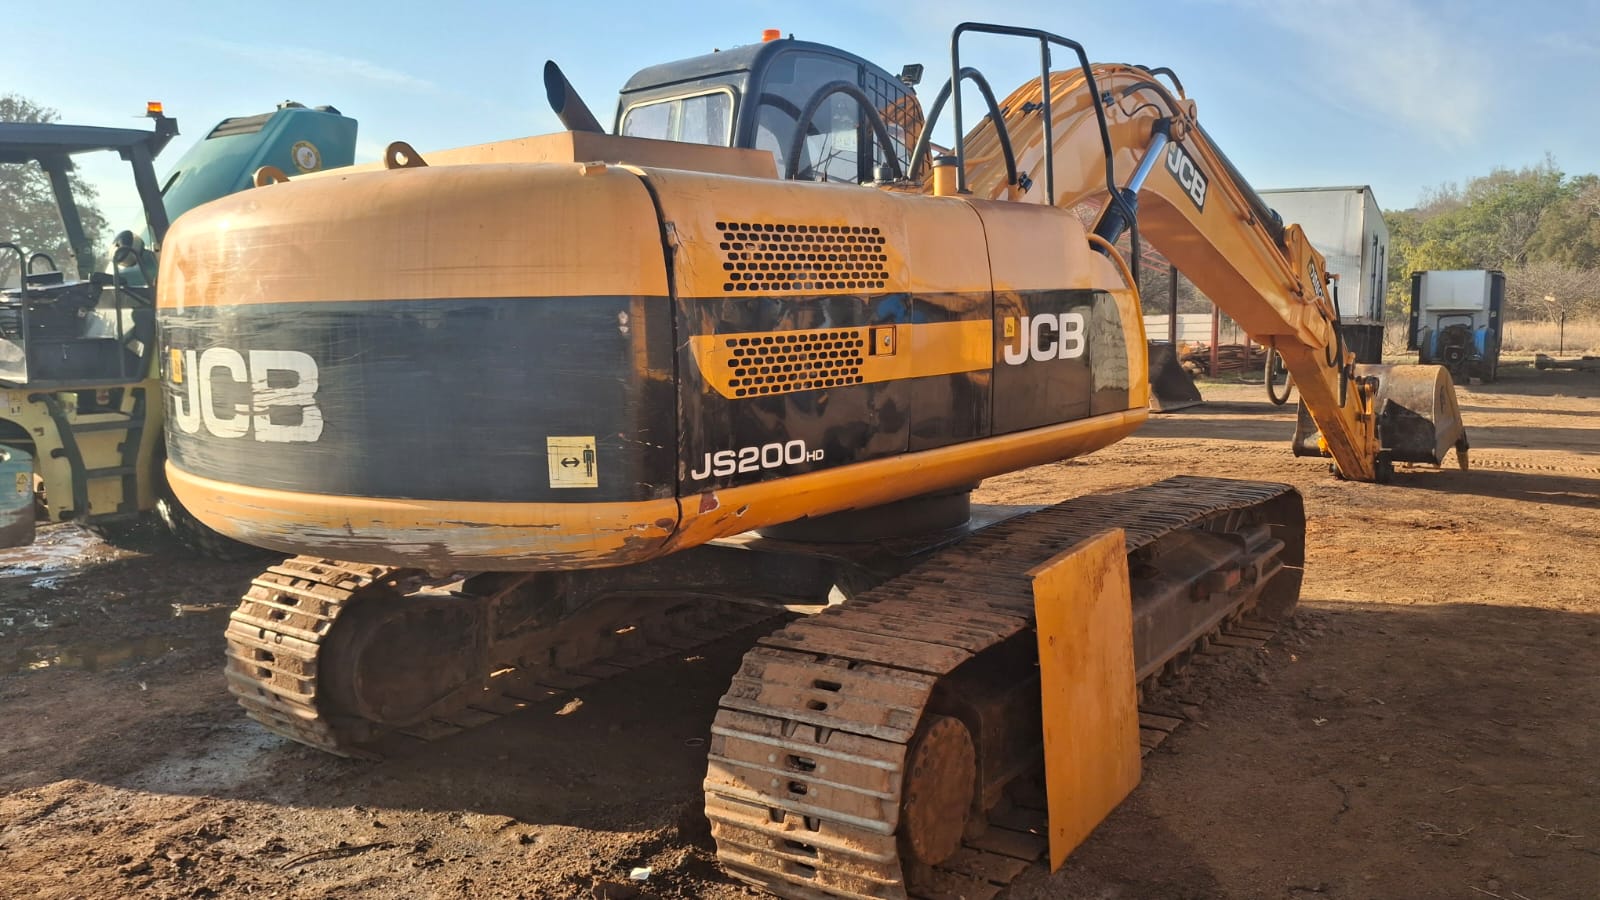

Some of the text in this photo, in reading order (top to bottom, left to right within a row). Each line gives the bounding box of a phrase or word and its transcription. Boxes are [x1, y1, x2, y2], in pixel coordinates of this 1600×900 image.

[1167, 147, 1206, 207] JCB
[1004, 313, 1085, 366] JCB
[174, 347, 324, 443] JCB
